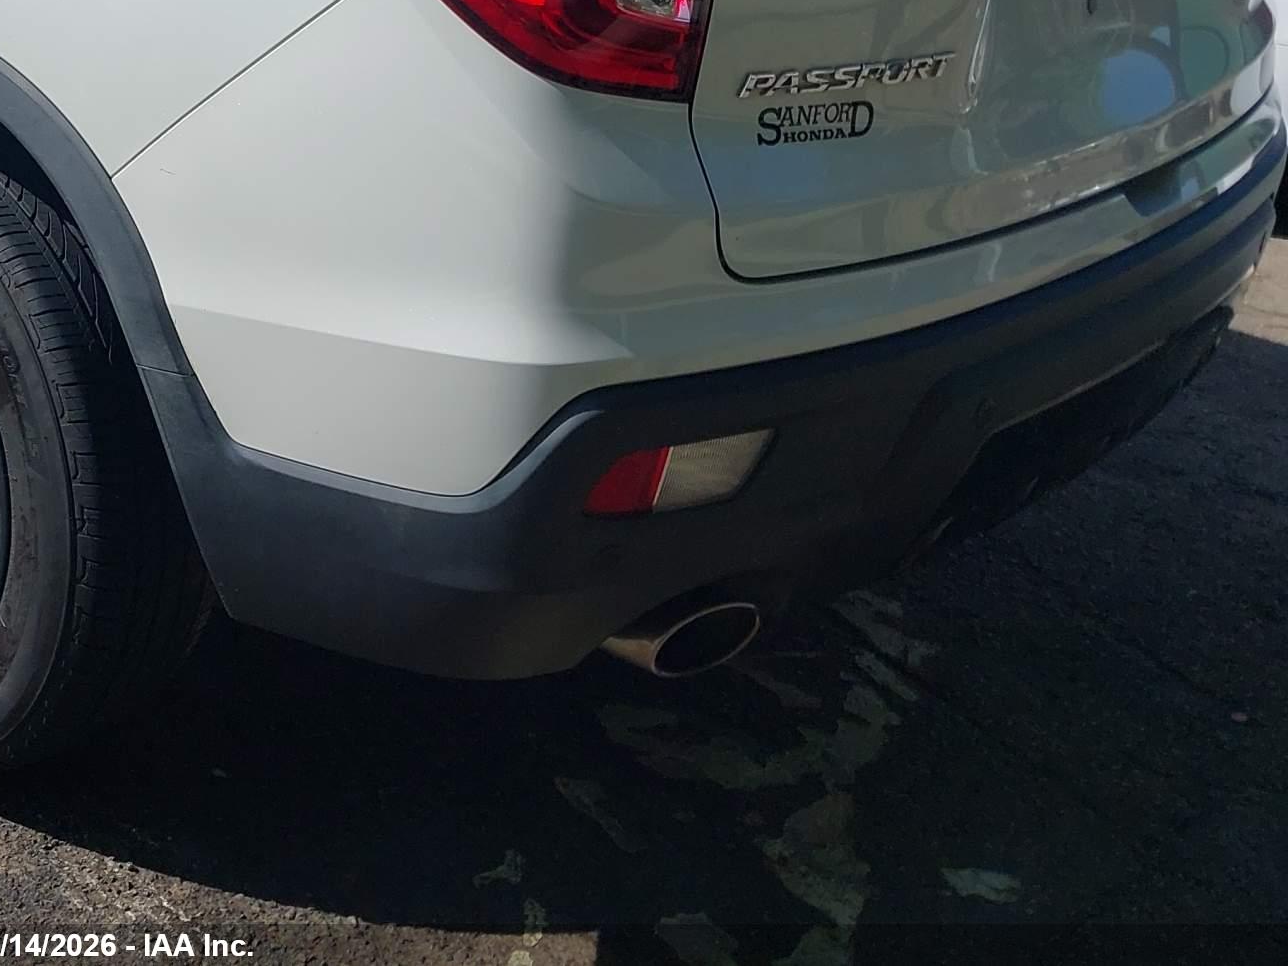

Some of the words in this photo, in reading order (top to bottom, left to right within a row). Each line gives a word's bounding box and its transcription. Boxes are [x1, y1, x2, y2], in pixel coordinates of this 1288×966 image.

[737, 51, 957, 98] PASSPORT
[757, 100, 874, 146] SANFORD
[783, 128, 849, 144] HONDA
